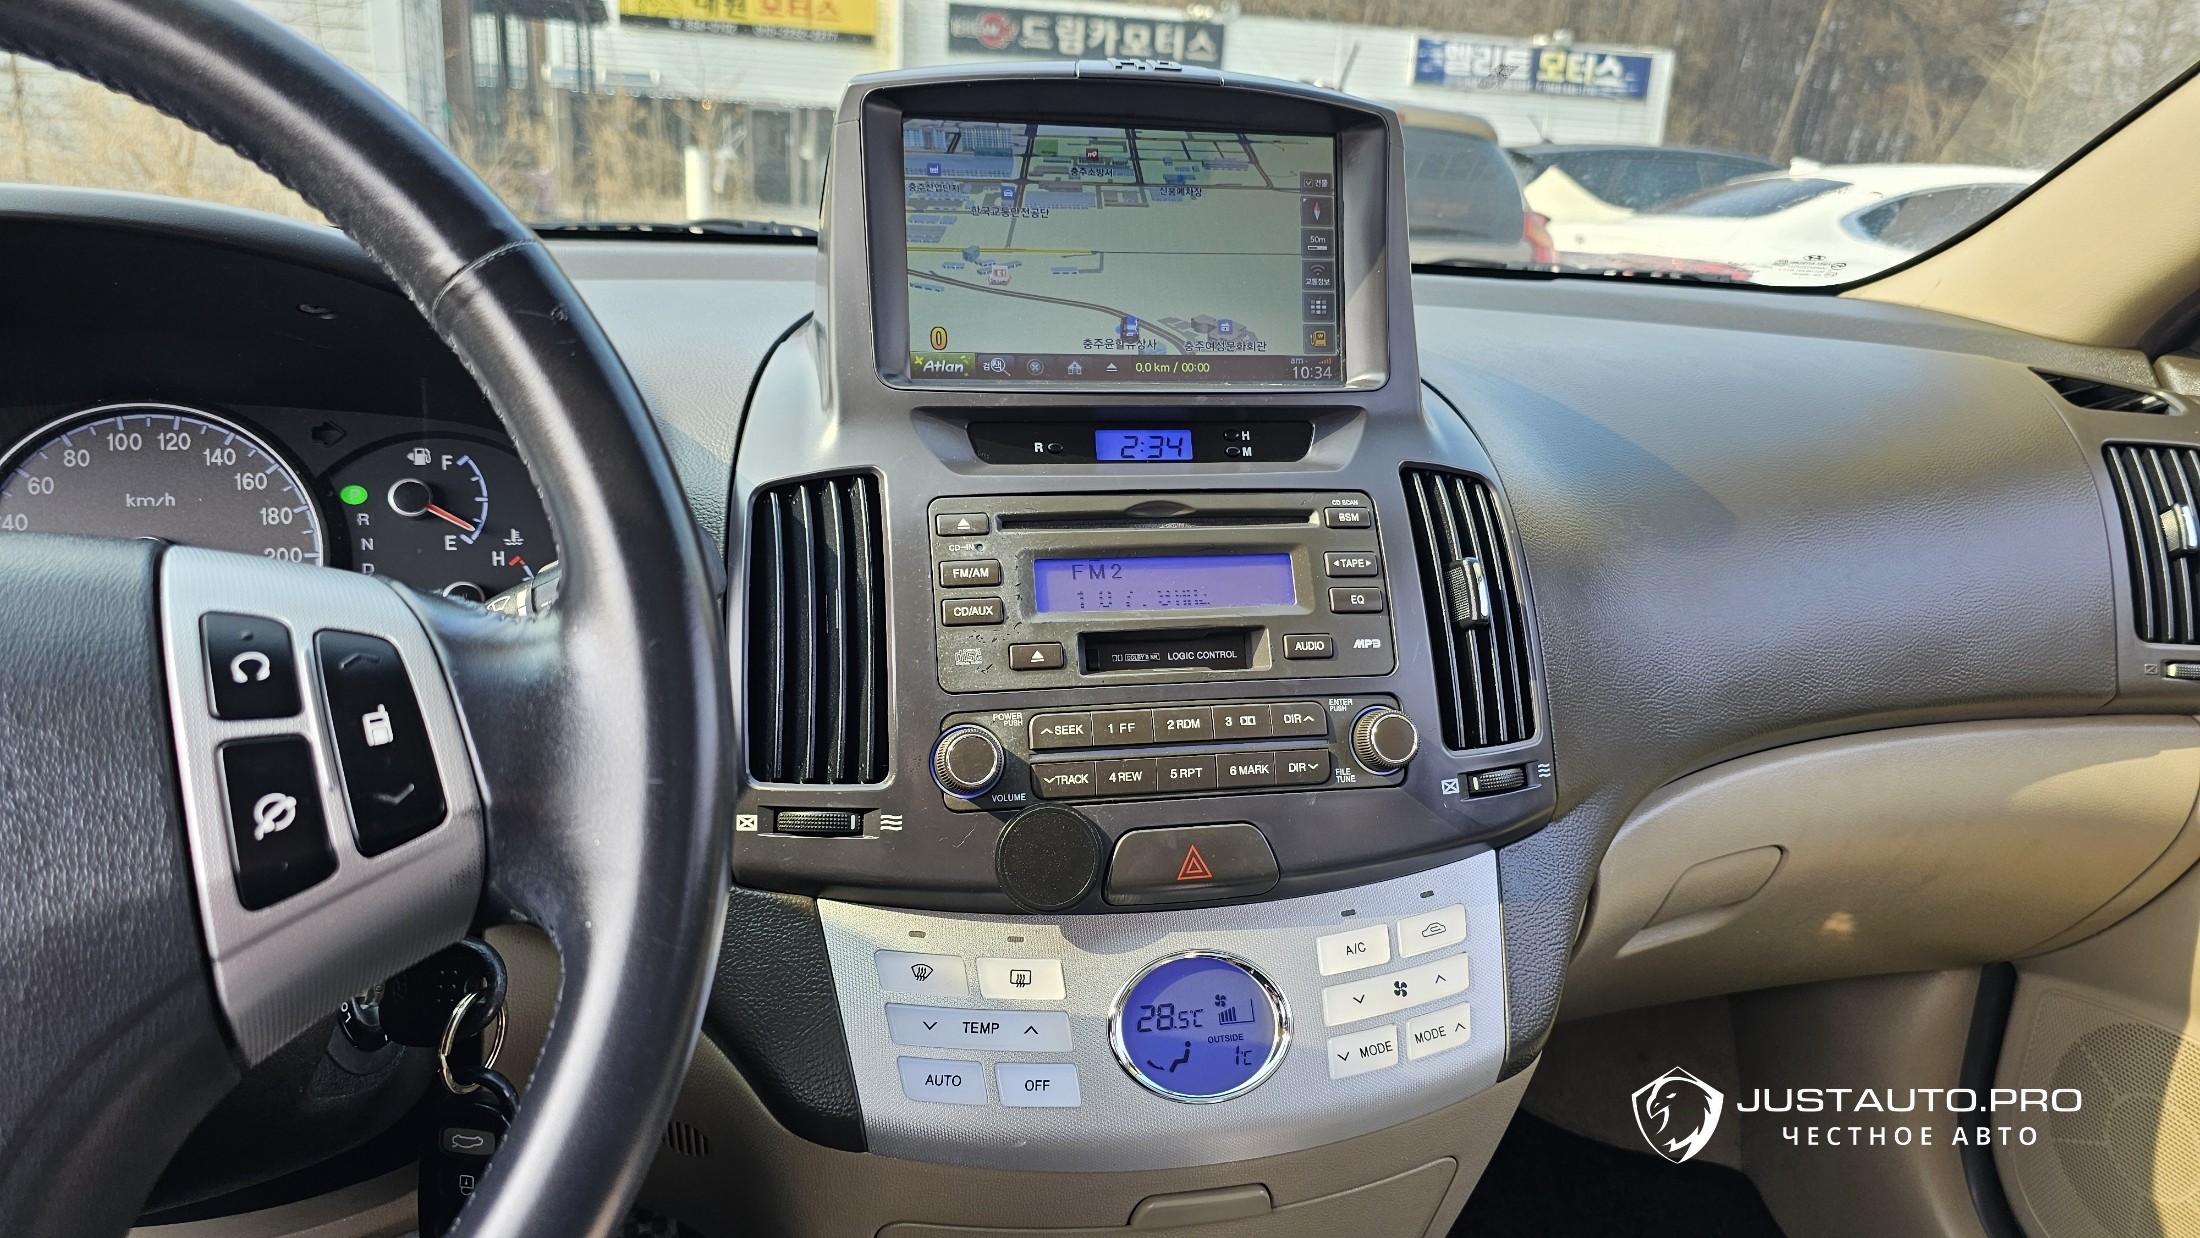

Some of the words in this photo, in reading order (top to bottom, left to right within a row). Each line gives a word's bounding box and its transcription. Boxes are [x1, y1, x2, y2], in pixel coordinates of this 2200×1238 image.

[1018, 14, 1219, 62] 드림카모터스
[1537, 48, 1625, 88] 모터스
[1070, 167, 1113, 177] 충주소방서
[970, 205, 1050, 219] 한국교통안전공단
[1310, 236, 1326, 244] 50m
[930, 326, 948, 351] 0
[1184, 340, 1267, 352] 충주여성문화회관
[923, 359, 964, 373] Atlan
[1153, 362, 1170, 373] km
[1181, 362, 1210, 373] 00:00
[1292, 366, 1333, 379] 10:34
[106, 433, 142, 451] 100
[157, 432, 191, 451] 120
[1241, 431, 1250, 441] H
[1034, 442, 1044, 452] R
[1121, 436, 1183, 459] 2:34
[1242, 447, 1252, 457] M
[63, 449, 90, 467] 80
[203, 448, 236, 466] 140
[442, 455, 453, 471] F
[27, 477, 55, 495] 60
[234, 473, 268, 491] 160
[126, 492, 176, 507] km/h
[1, 513, 28, 531] 40
[260, 507, 293, 526] 180
[357, 514, 370, 526] R
[1338, 513, 1359, 522] BSM
[361, 538, 374, 550] N
[445, 535, 457, 551] E
[492, 551, 505, 567] H
[1340, 558, 1365, 568] TAPE
[953, 567, 989, 578] FM/AM
[1072, 563, 1122, 580] FM2
[1350, 595, 1365, 605] EQ
[953, 605, 993, 617] CD/AUX
[1294, 640, 1325, 651] AUDIO
[1353, 638, 1381, 649] MP3
[1167, 651, 1194, 661] LOGIC
[1196, 650, 1237, 660] CONTROL
[992, 712, 1023, 721] POWER
[1225, 717, 1233, 726] 3
[1283, 714, 1302, 724] DIR
[1054, 724, 1084, 735] SEEK
[1107, 724, 1114, 734] 1
[1119, 723, 1135, 733] FF
[1166, 720, 1174, 730] 2
[1176, 719, 1201, 729] RDM
[1169, 769, 1178, 779] 5
[1179, 768, 1203, 778] RPT
[1229, 766, 1237, 776] 6
[1238, 764, 1270, 775] MARK
[1288, 762, 1306, 773] DIR
[1056, 774, 1089, 785] TRACK
[1109, 773, 1117, 783] 4
[1118, 771, 1143, 782] REW
[1335, 774, 1356, 783] TUNE
[991, 793, 1027, 802] VOLUME
[1346, 942, 1367, 956] A/C
[963, 1021, 1000, 1035] TEMP
[1207, 1033, 1245, 1044] OUTSIDE
[1414, 1025, 1447, 1044] MODE
[1359, 1040, 1394, 1059] MODE
[924, 1074, 962, 1088] AUTO
[1024, 1079, 1050, 1092] OFF
